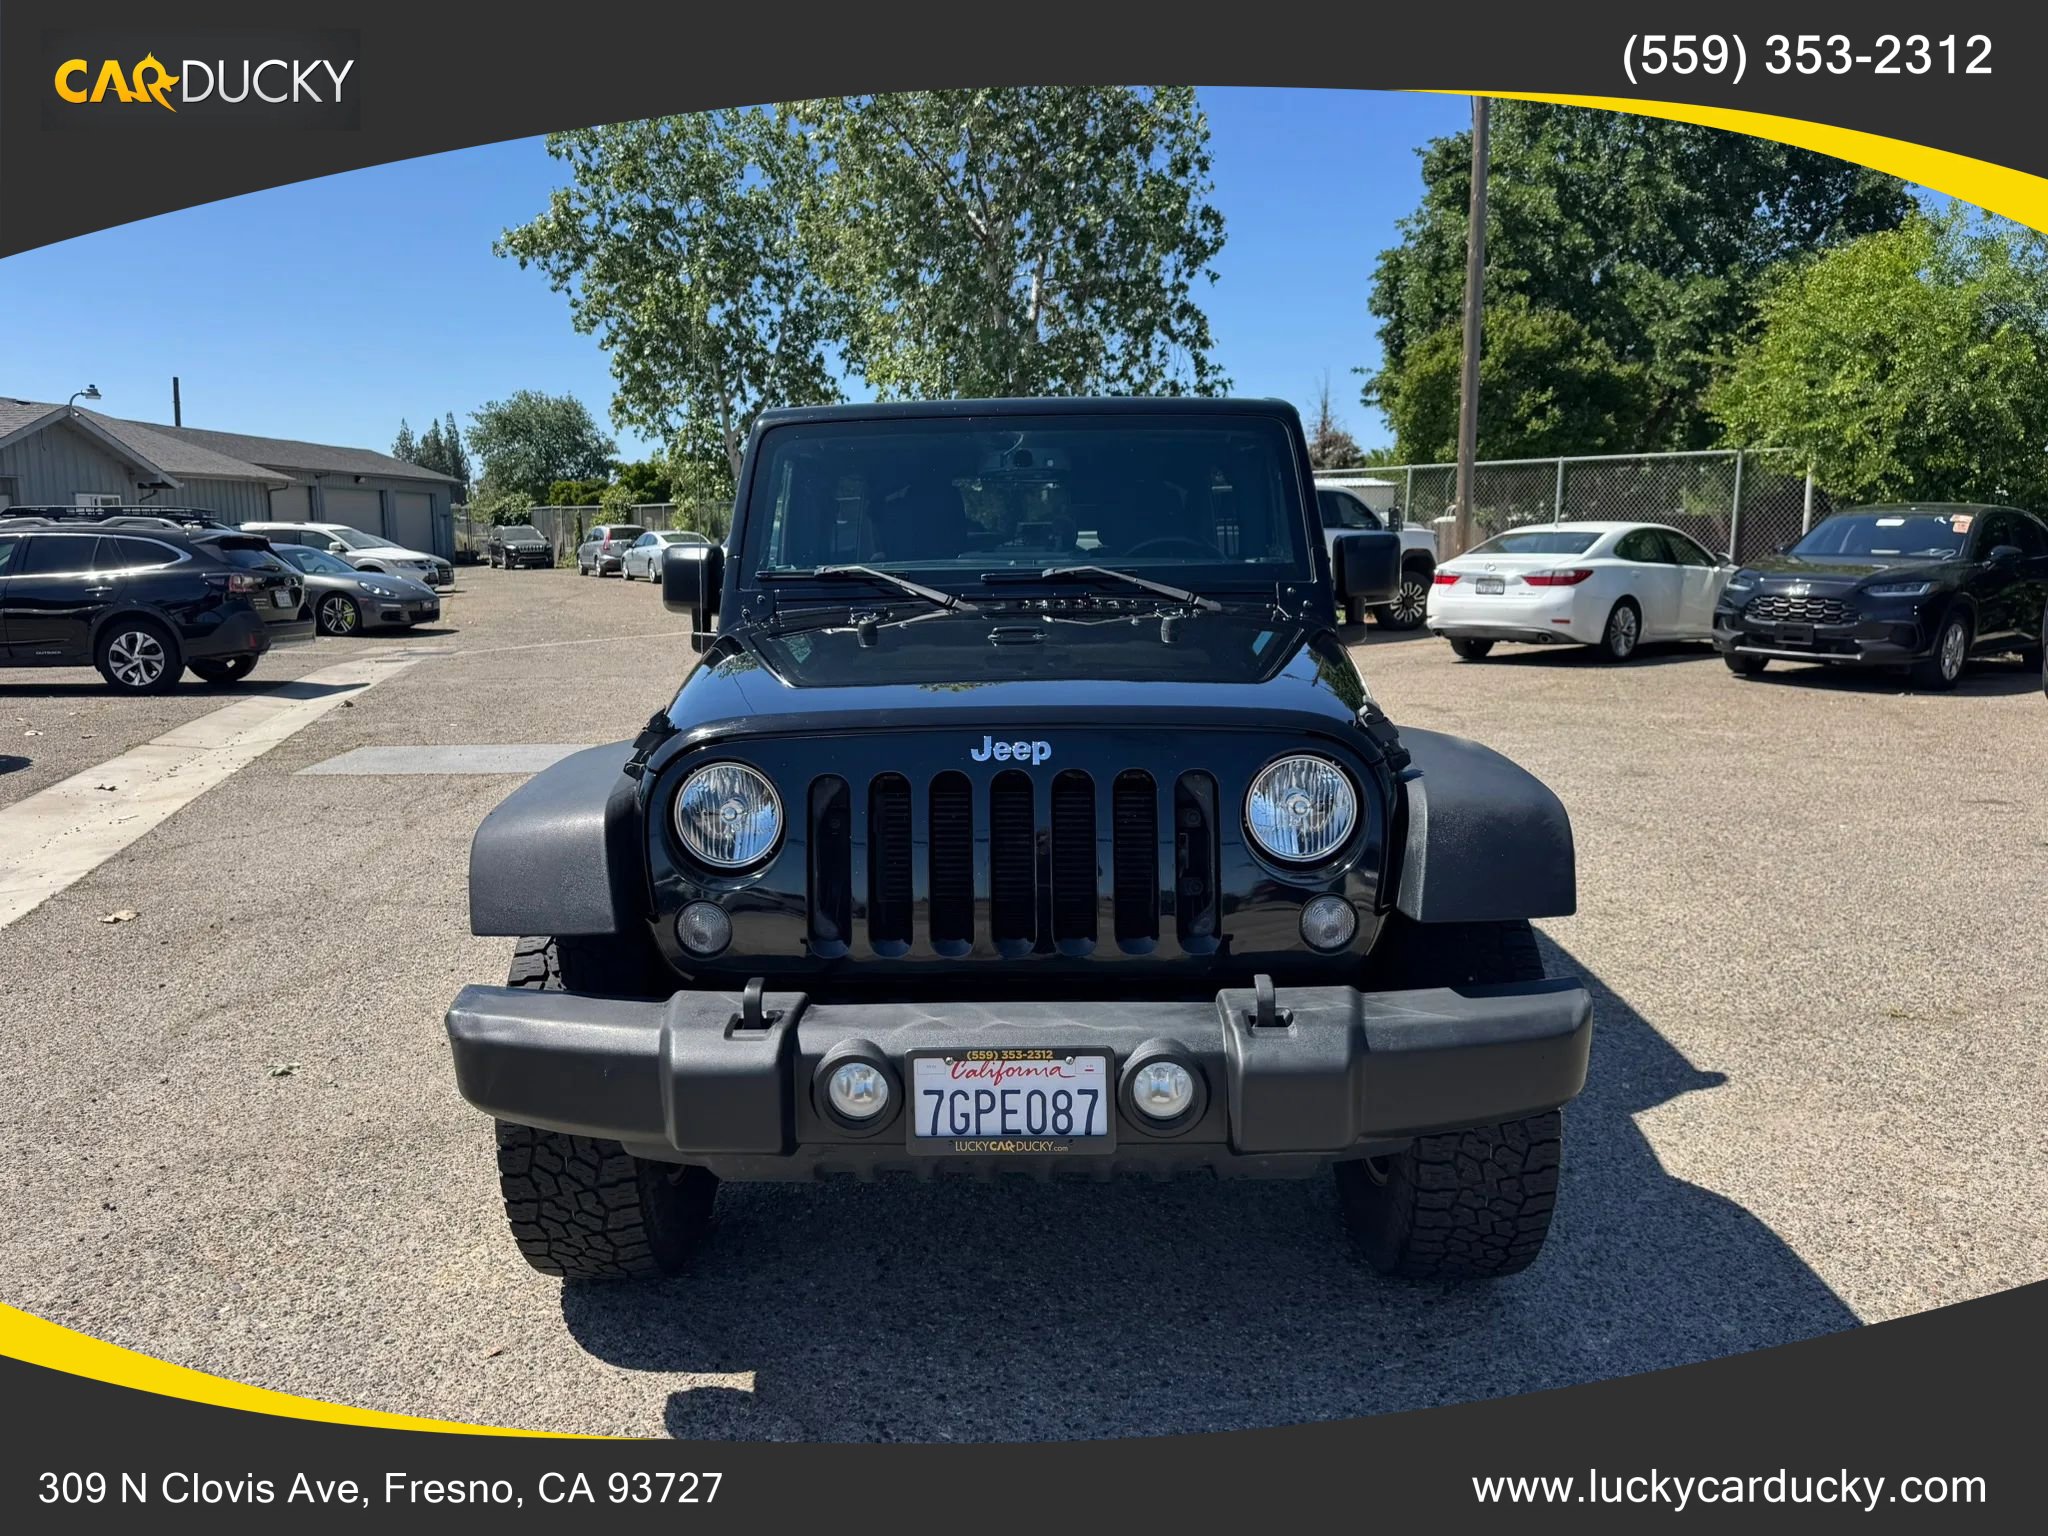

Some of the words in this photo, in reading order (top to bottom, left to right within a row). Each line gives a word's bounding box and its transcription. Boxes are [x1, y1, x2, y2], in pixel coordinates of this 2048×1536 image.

[970, 735, 1052, 766] Jeep
[966, 1050, 999, 1061] (559)
[1001, 1050, 1054, 1060] 353-2312
[951, 1060, 1076, 1086] California
[922, 1089, 1100, 1136] 7GPE087
